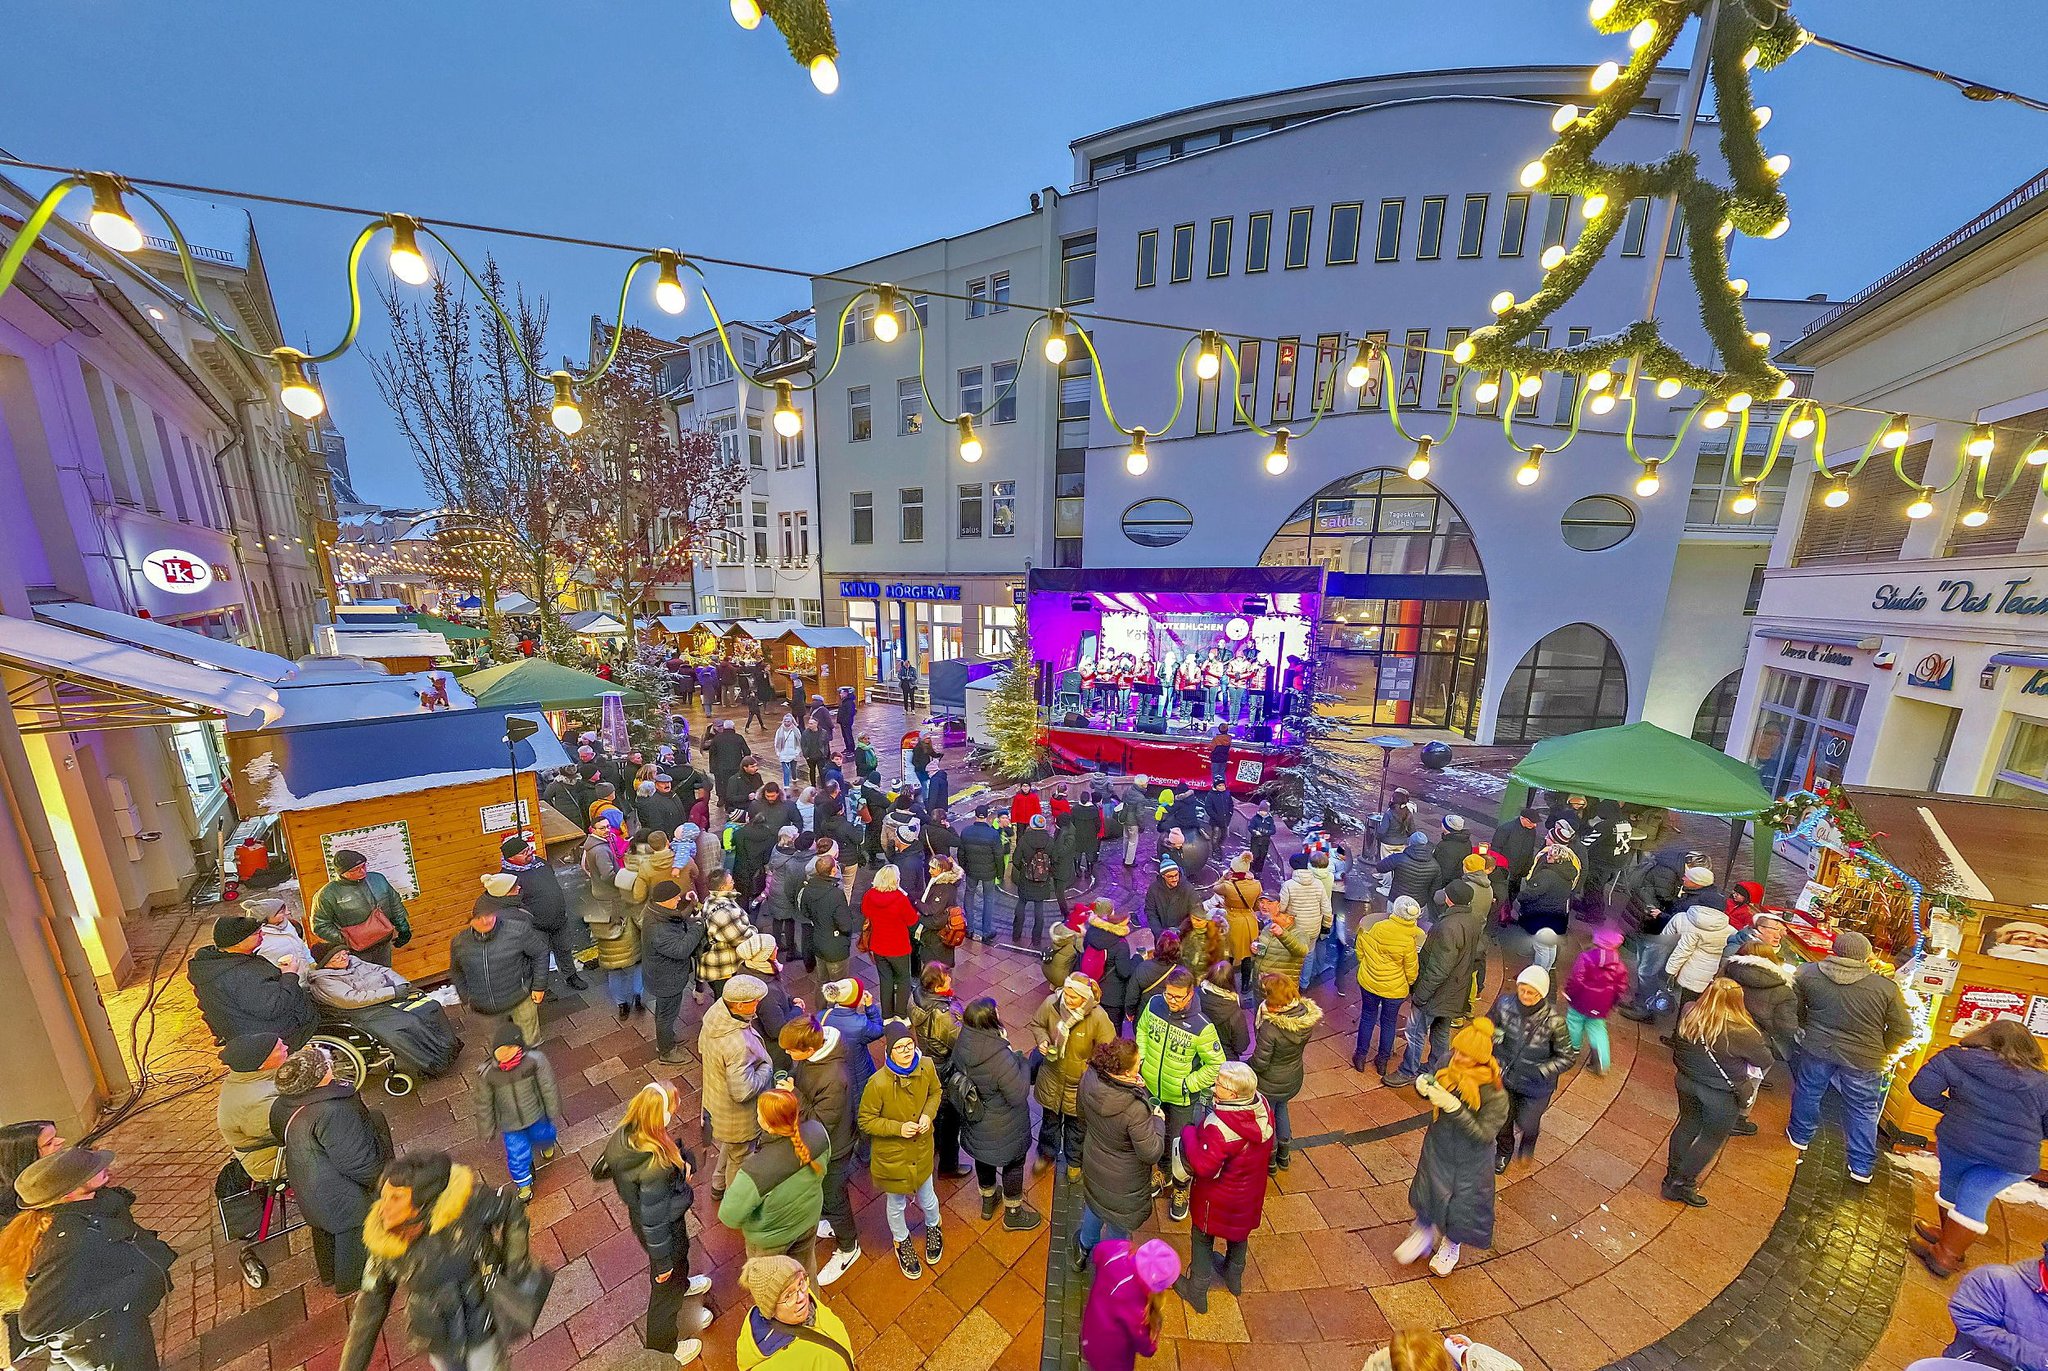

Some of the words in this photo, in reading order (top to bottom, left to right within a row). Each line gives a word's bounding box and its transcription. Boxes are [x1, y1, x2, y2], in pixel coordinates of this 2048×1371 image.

[164, 562, 195, 582] HK
[840, 582, 880, 598] KIND
[886, 583, 961, 600] HÖRGERÄTE
[1872, 584, 1928, 611] Studio
[1156, 622, 1224, 632] ROTKEHLCHEN
[1826, 737, 1846, 757] 60
[1170, 1025, 1193, 1041] SAILING
